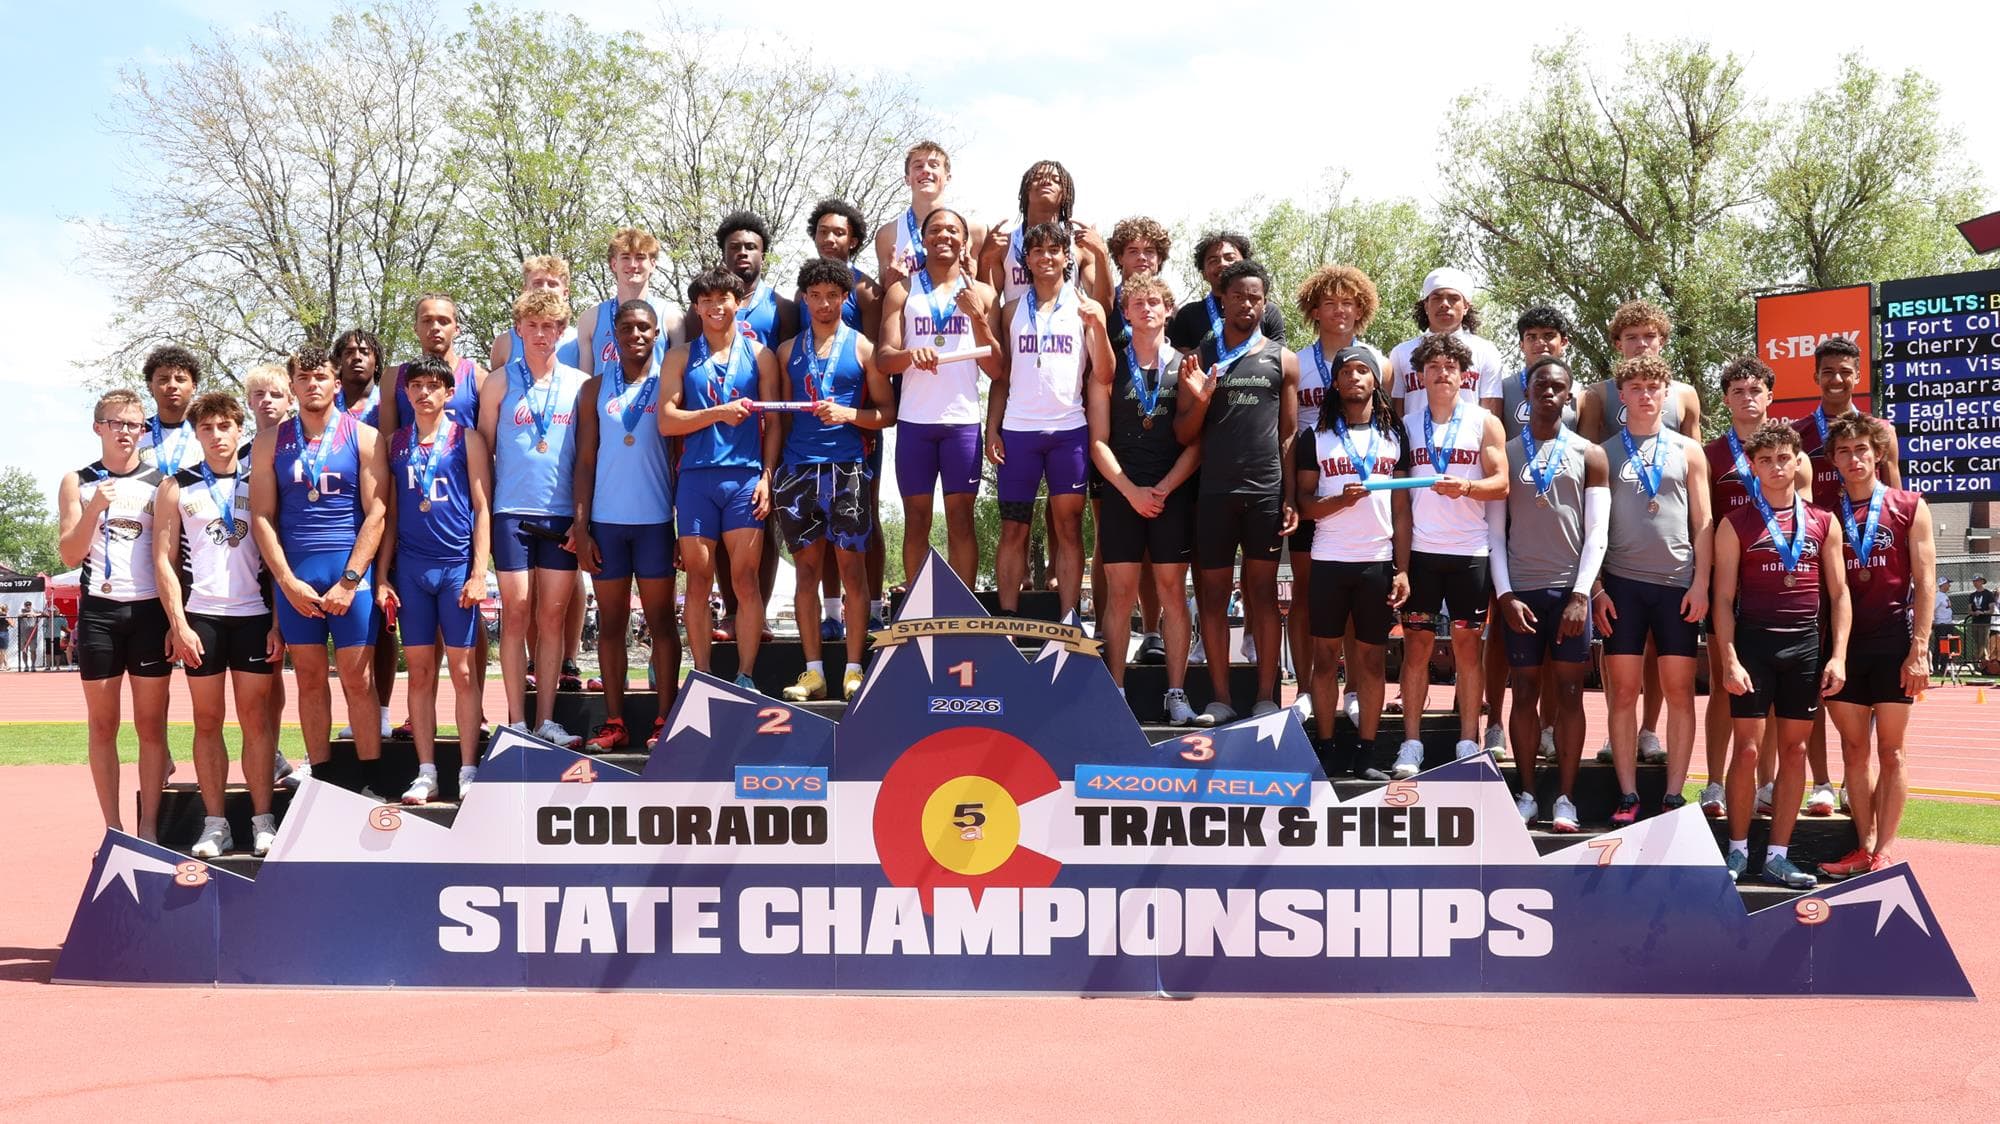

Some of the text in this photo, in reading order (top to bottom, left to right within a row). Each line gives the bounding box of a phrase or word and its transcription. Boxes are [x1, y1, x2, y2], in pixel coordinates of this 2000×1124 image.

[1888, 294, 1985, 318] RESULTS:
[1884, 322, 1895, 338] 1
[1907, 318, 1952, 336] Fort
[1884, 342, 1894, 358] 2
[1907, 338, 1978, 355] Cherry
[1885, 363, 1895, 378] 3
[1906, 361, 1951, 377] Mtn.
[1884, 383, 1895, 399] 4
[1886, 403, 1896, 419] 5
[1909, 412, 2000, 433] Fountain
[1908, 456, 1954, 474] Rock
[1909, 474, 1991, 493] Horizon
[898, 620, 1075, 638] STATE CHAMPION
[948, 661, 975, 687] 1
[930, 698, 1001, 713] 2026
[756, 707, 792, 734] 2
[1180, 736, 1215, 761] 3
[561, 759, 598, 783] 4
[742, 776, 822, 791] BOYS
[1087, 775, 1306, 797] 4X200M RELAY
[1384, 780, 1419, 807] 5
[369, 806, 401, 831] 6
[537, 806, 828, 845] COLORADO
[953, 803, 986, 829] 5
[1075, 806, 1475, 847] TRACK & FIELD
[1588, 838, 1623, 866] 7
[175, 860, 208, 887] 8
[438, 886, 1554, 957] STATE CHAMPIONSHIPS
[1795, 897, 1831, 926] 9
